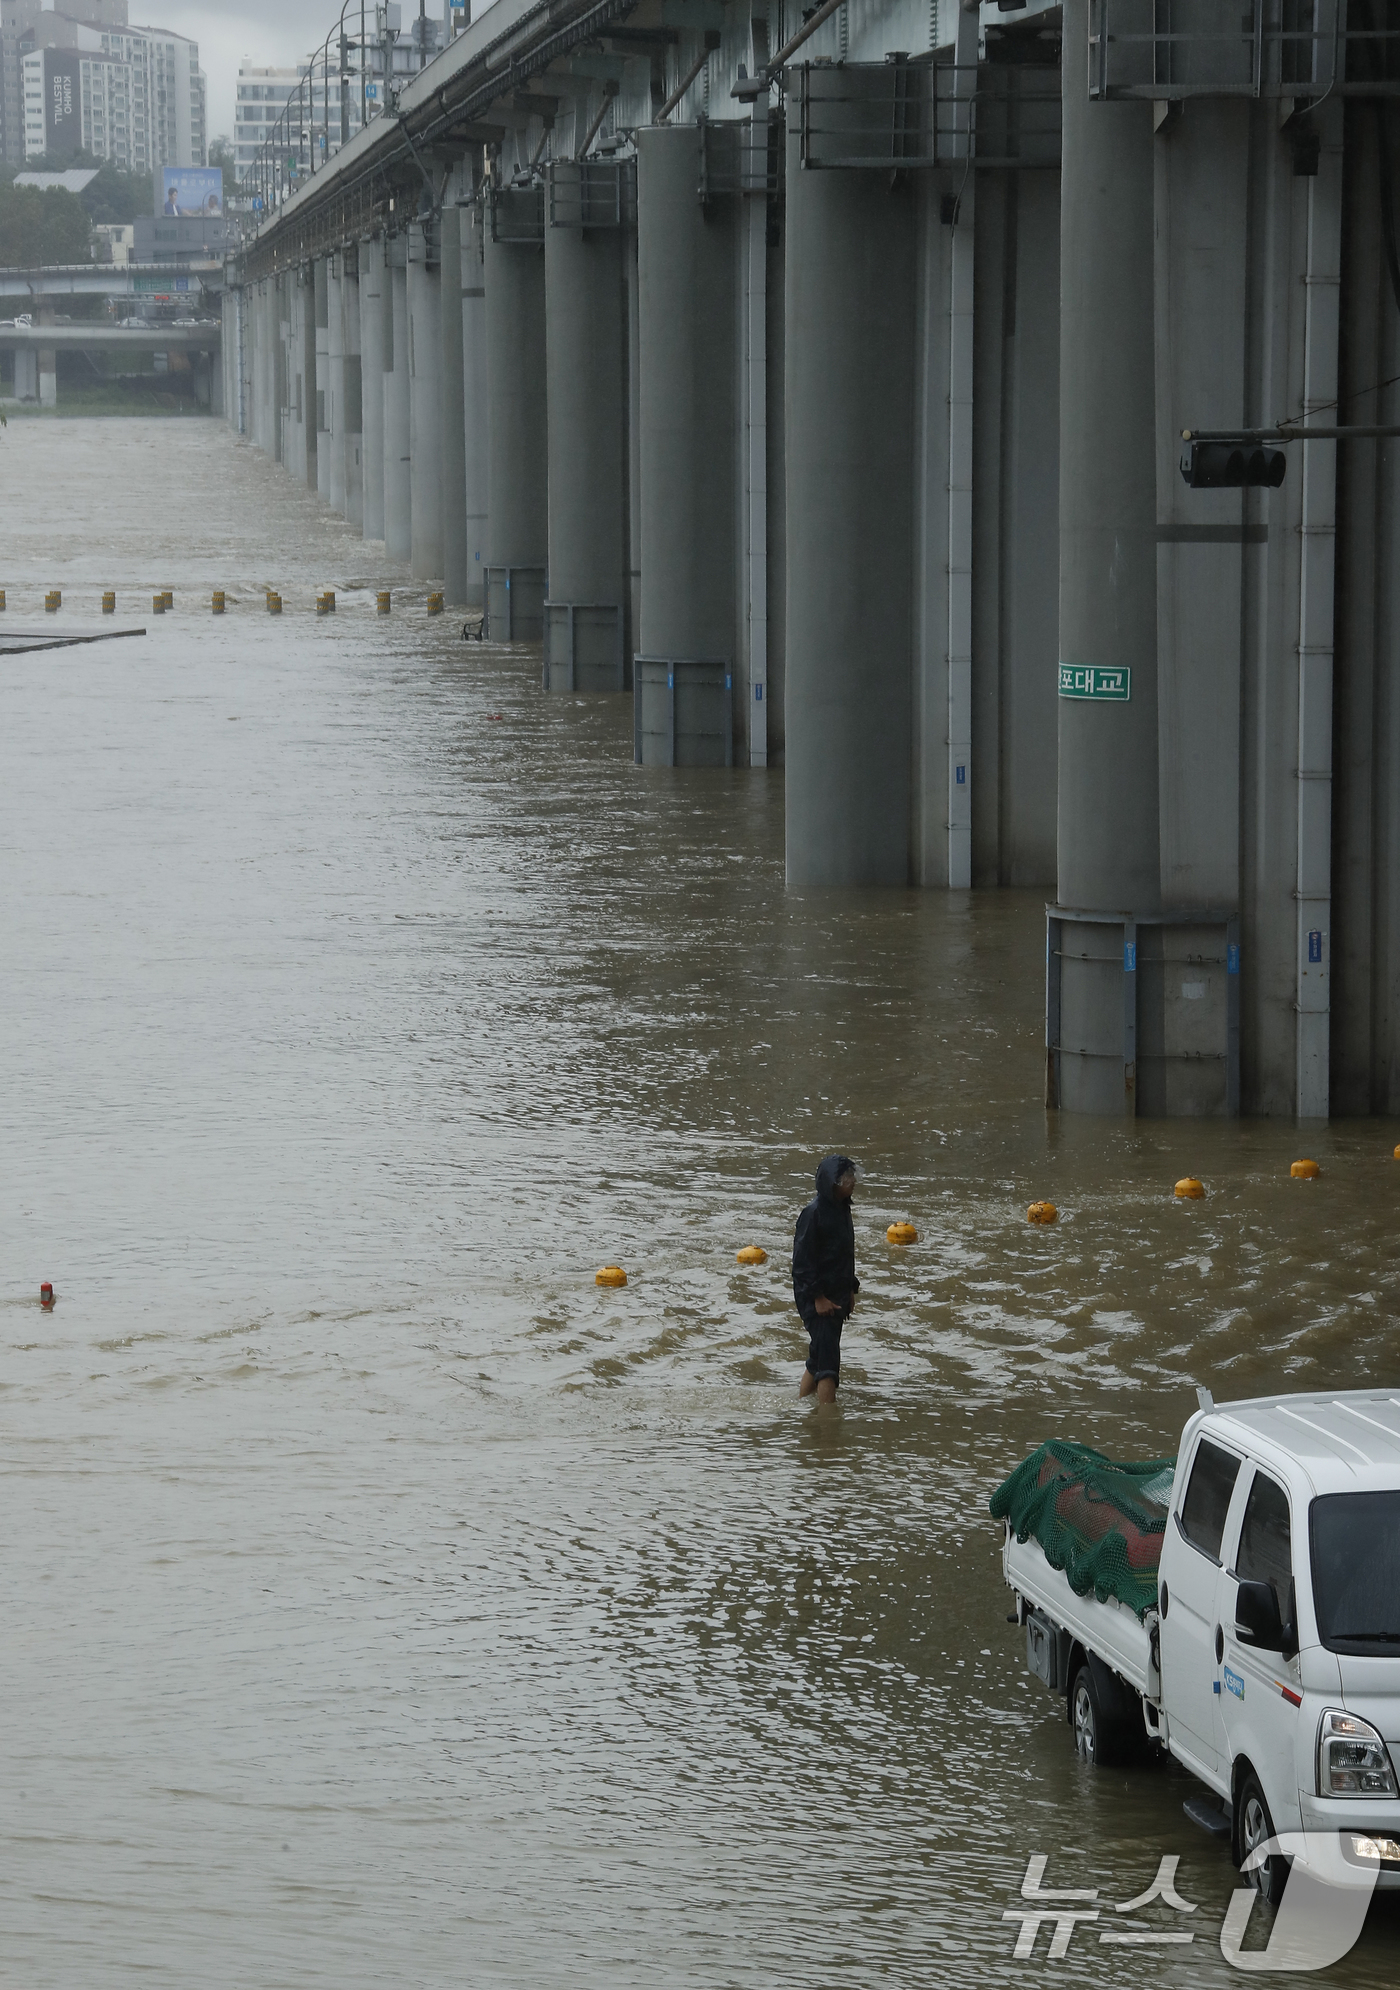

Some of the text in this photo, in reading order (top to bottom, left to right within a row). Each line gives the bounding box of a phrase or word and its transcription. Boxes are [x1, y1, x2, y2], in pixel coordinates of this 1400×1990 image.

[53, 76, 62, 125] BESTVILL
[63, 76, 72, 114] KUMHO
[1059, 669, 1124, 693] 포대교
